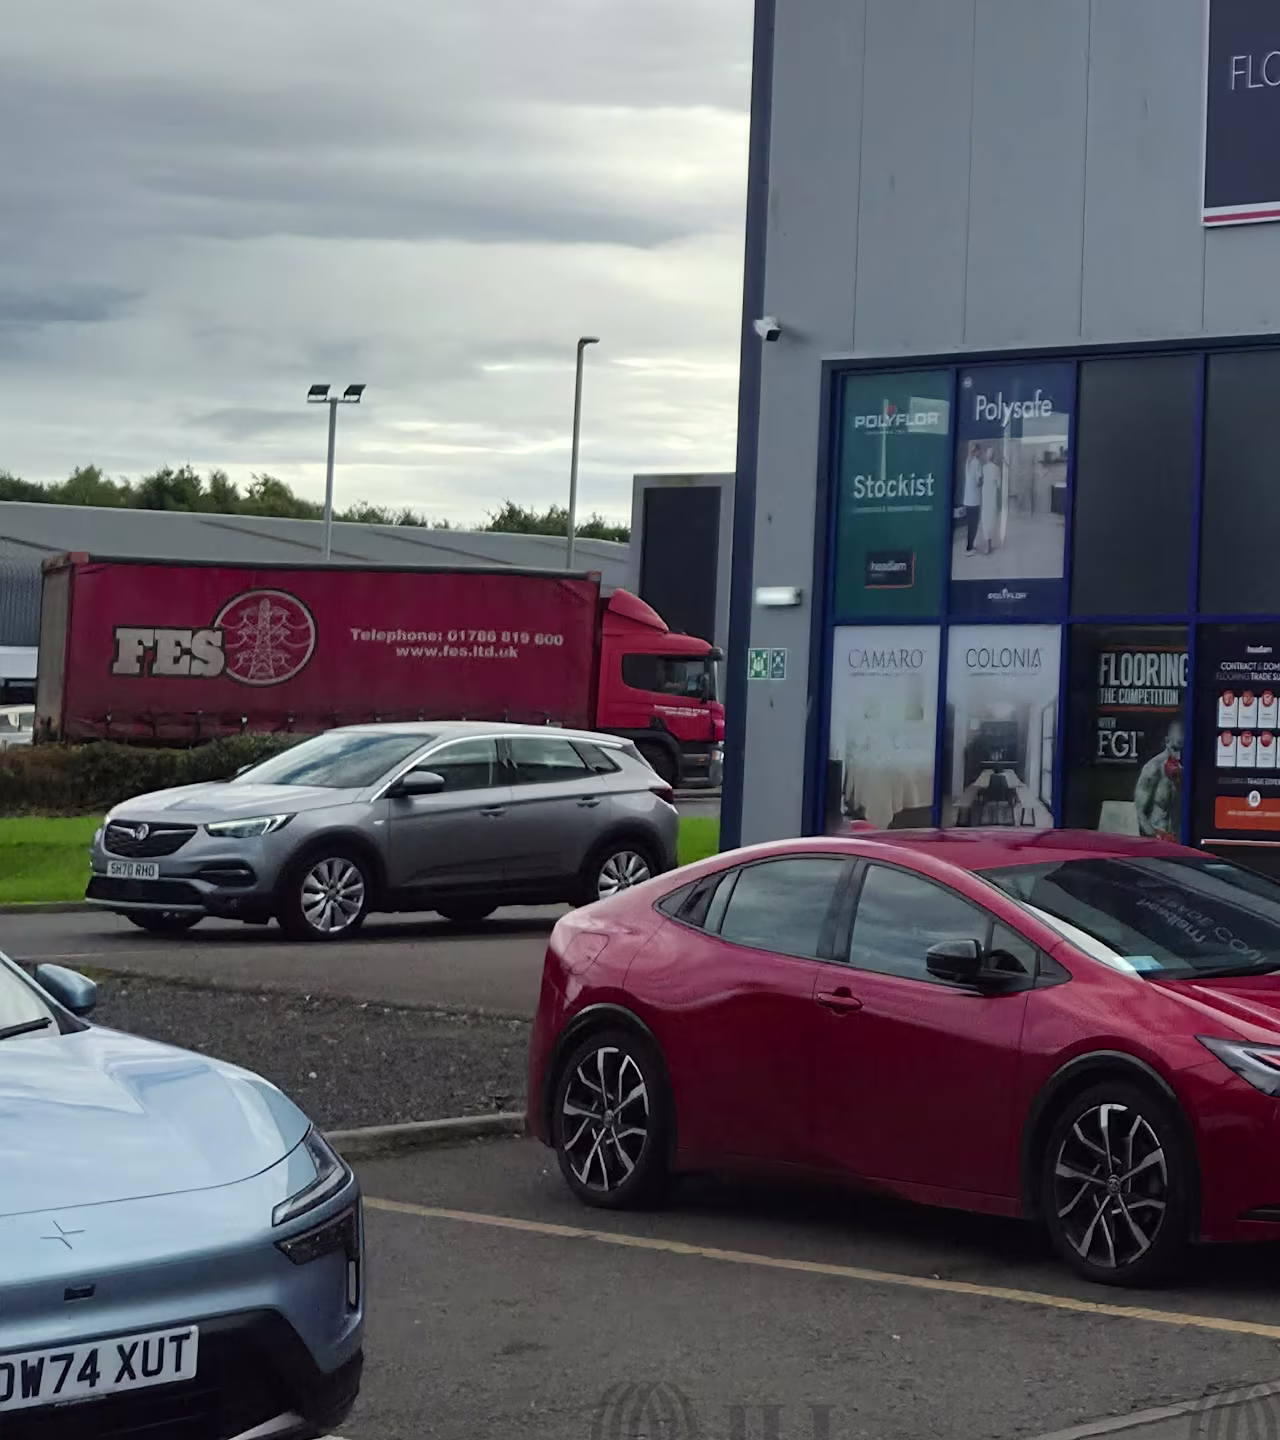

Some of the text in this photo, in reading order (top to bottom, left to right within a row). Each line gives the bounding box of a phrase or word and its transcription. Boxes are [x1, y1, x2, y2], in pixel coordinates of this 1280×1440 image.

[976, 389, 1052, 427] Polysafe
[854, 412, 939, 428] POLYFLOR
[853, 473, 935, 498] Stockist
[350, 628, 442, 644] Telephone:
[112, 627, 225, 677] FES
[847, 648, 924, 669] CAMARO
[966, 648, 1042, 668] COLONIA
[1100, 653, 1188, 687] FLOORING
[1220, 662, 1257, 670] CONTRACT
[1100, 688, 1179, 705] THE COMPETITION
[114, 1333, 191, 1383] XUT
